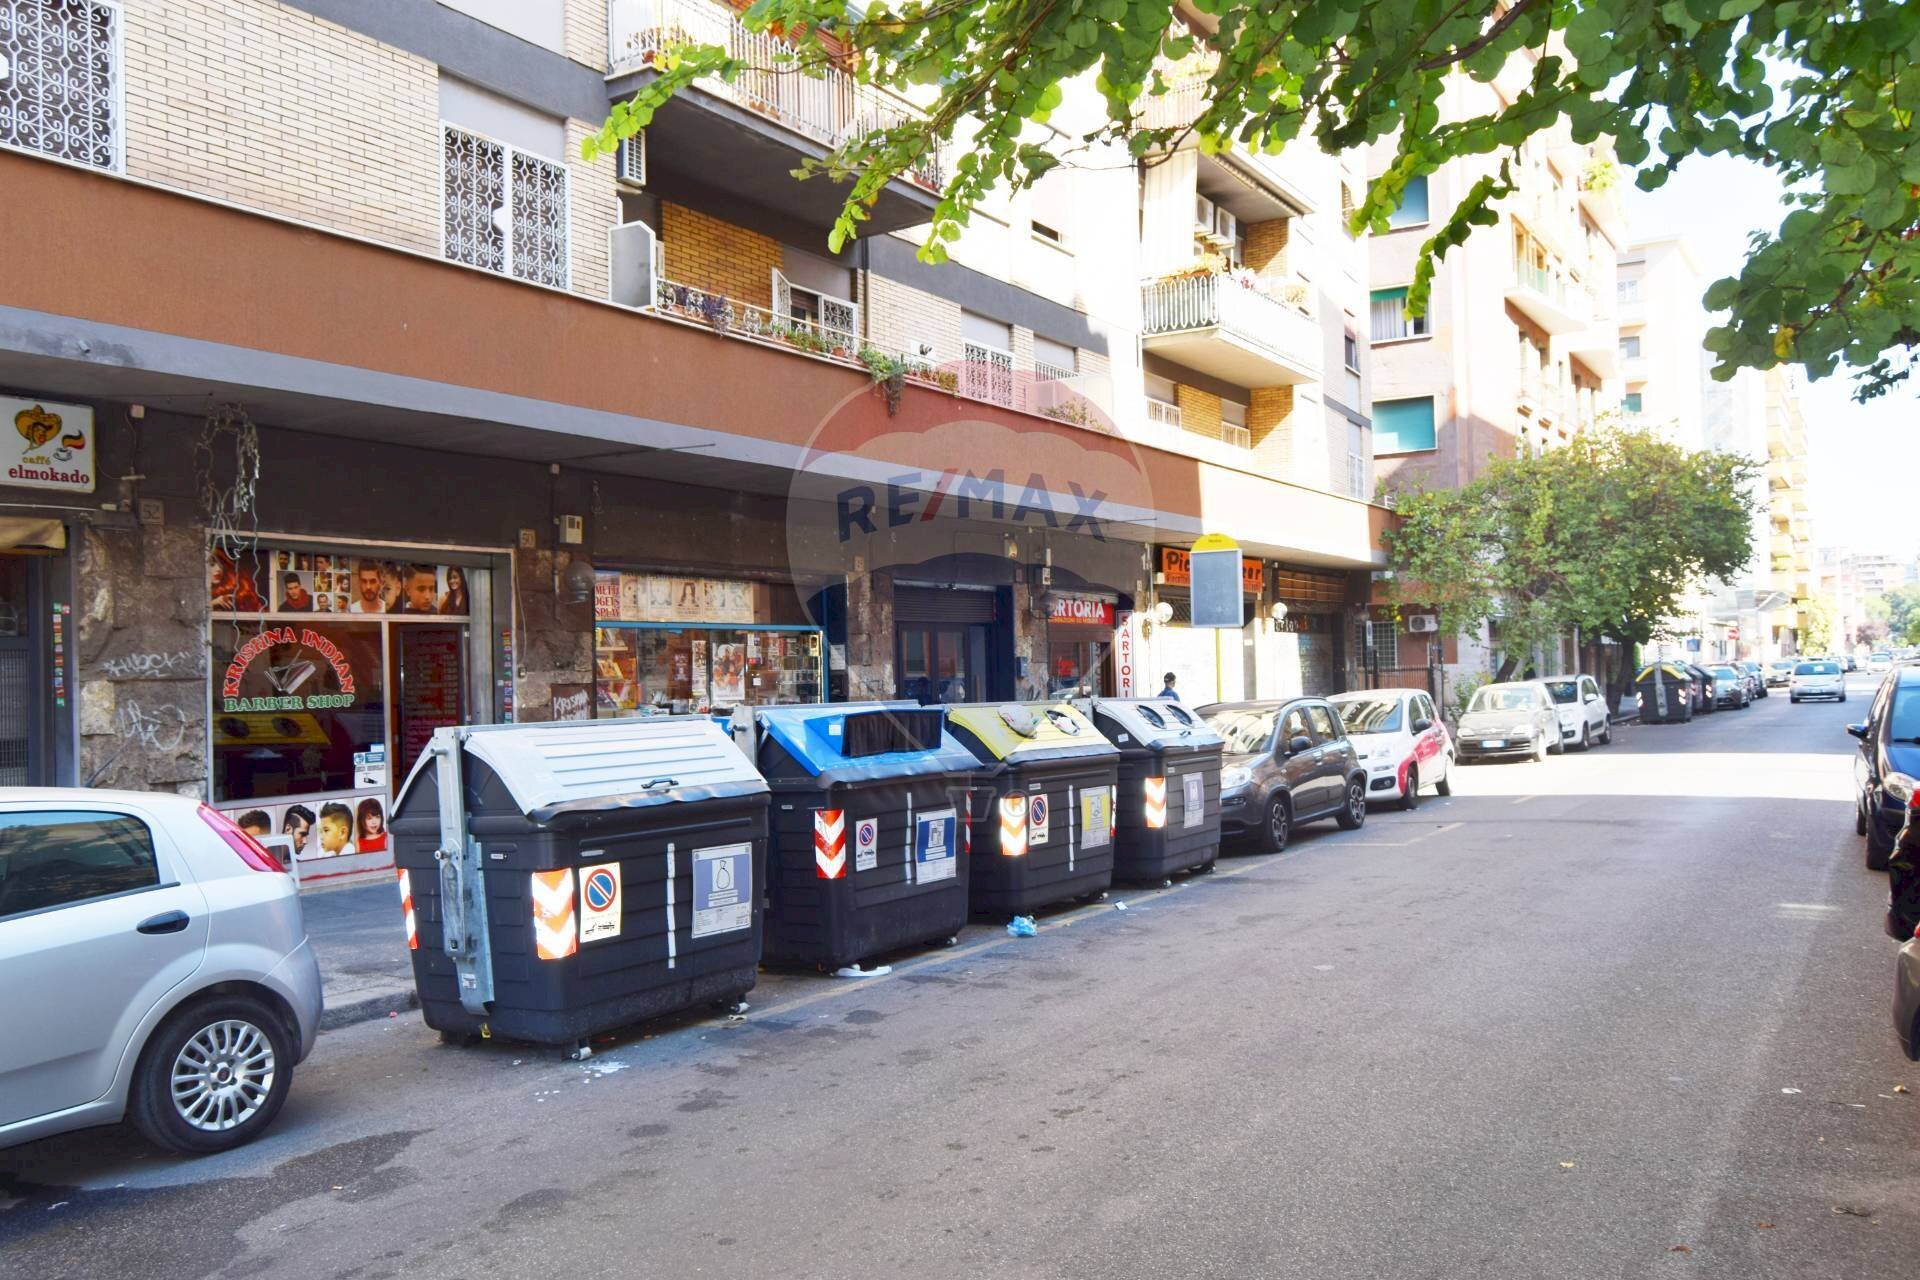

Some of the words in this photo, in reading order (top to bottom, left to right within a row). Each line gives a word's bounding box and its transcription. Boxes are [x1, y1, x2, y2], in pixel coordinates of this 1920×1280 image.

[8, 464, 90, 484] elmokado
[222, 626, 297, 698] KRISHNA
[301, 628, 356, 694] INDIAN
[223, 695, 304, 713] BARBER
[306, 694, 356, 710] SHOP
